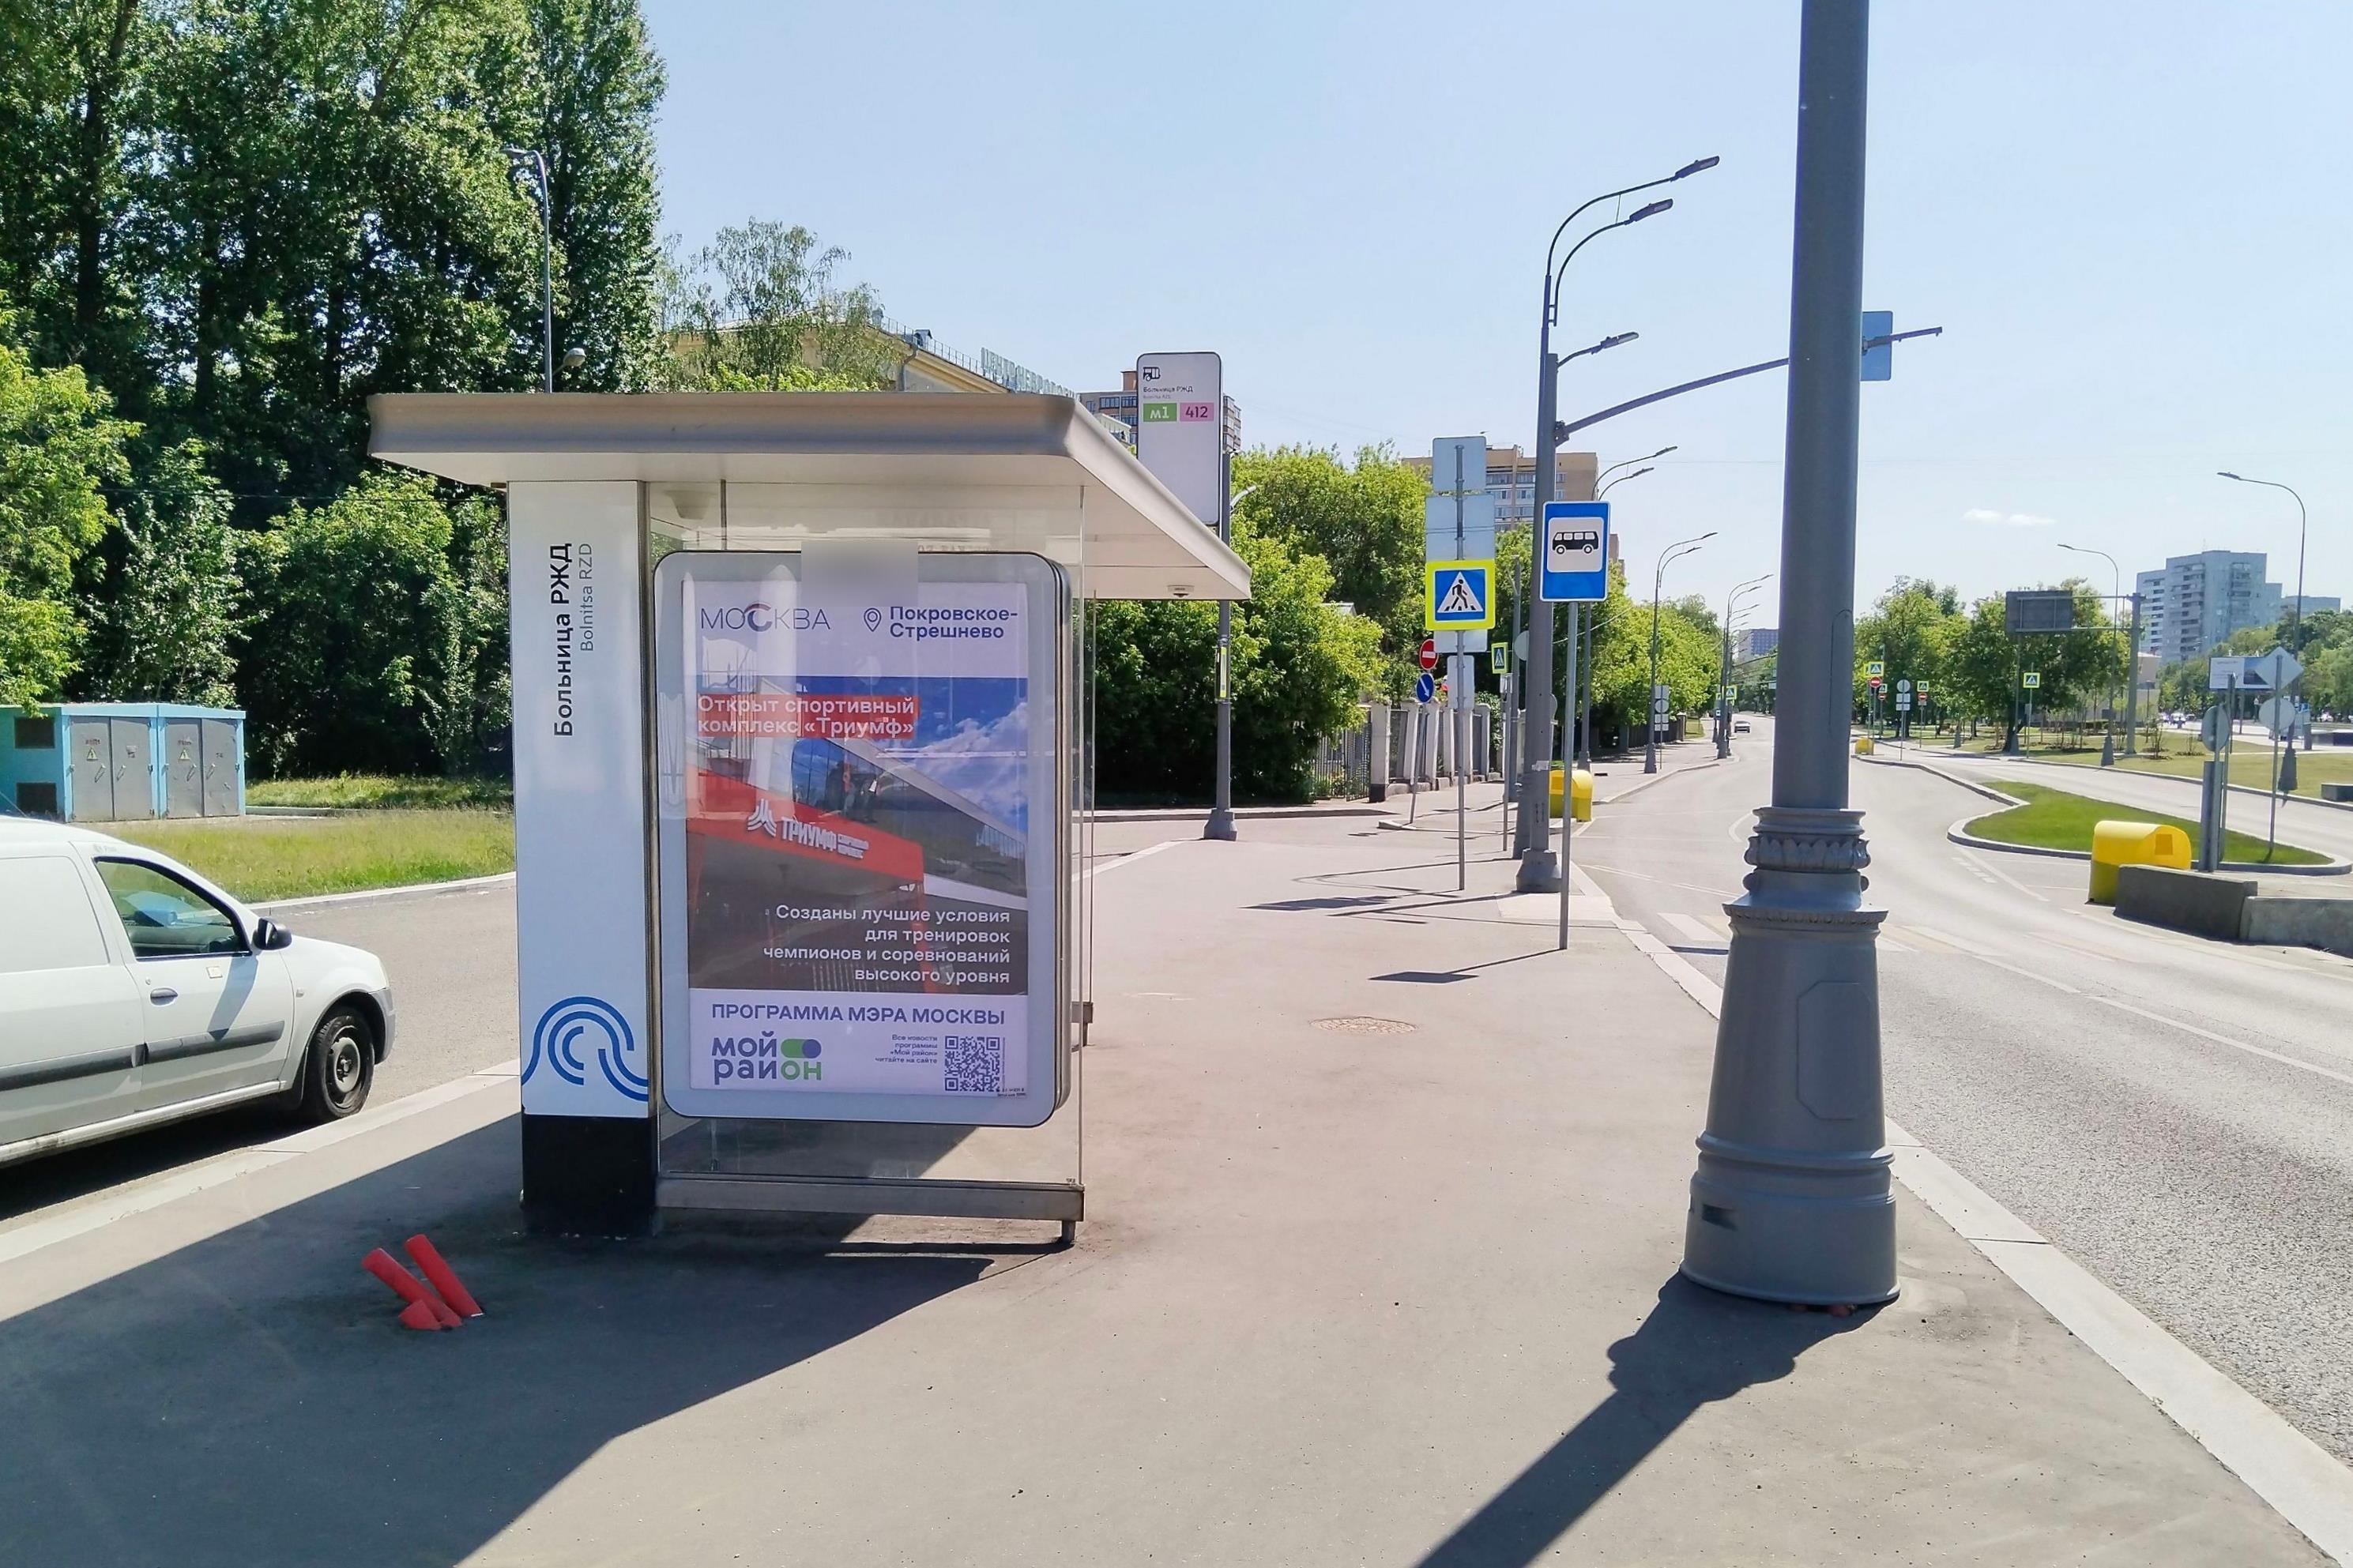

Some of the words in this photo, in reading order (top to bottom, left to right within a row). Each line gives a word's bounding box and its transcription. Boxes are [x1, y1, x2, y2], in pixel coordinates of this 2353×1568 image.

[1185, 405, 1209, 418] 412
[578, 543, 593, 580] RZD
[550, 543, 572, 604] РЖД
[579, 585, 593, 652] Bolnitsa
[700, 601, 831, 632] МОСКВА
[890, 606, 1018, 623] Покровское-
[890, 622, 1004, 641] Стрешнево
[554, 613, 574, 736] Больница
[698, 696, 778, 716] Открыт
[785, 697, 915, 716] спортивный
[698, 718, 800, 733] комплекс
[804, 716, 914, 739] «Триумф»
[781, 816, 838, 852] ТРИУМФ
[776, 904, 856, 920] Созданы
[861, 909, 931, 924] лучшие
[936, 910, 1010, 924] условия
[865, 929, 898, 942] для
[902, 930, 1010, 945] тренировок
[763, 948, 861, 961] чемпионов
[866, 950, 877, 961] и
[881, 949, 1010, 963] соревнований
[854, 969, 940, 983] высокого
[945, 971, 1010, 985] уровня
[712, 1003, 843, 1021] ПРОГРАММА
[849, 1006, 907, 1023] МЭРА
[912, 1008, 1005, 1025] МОСКВЫ
[711, 1030, 777, 1058] мой
